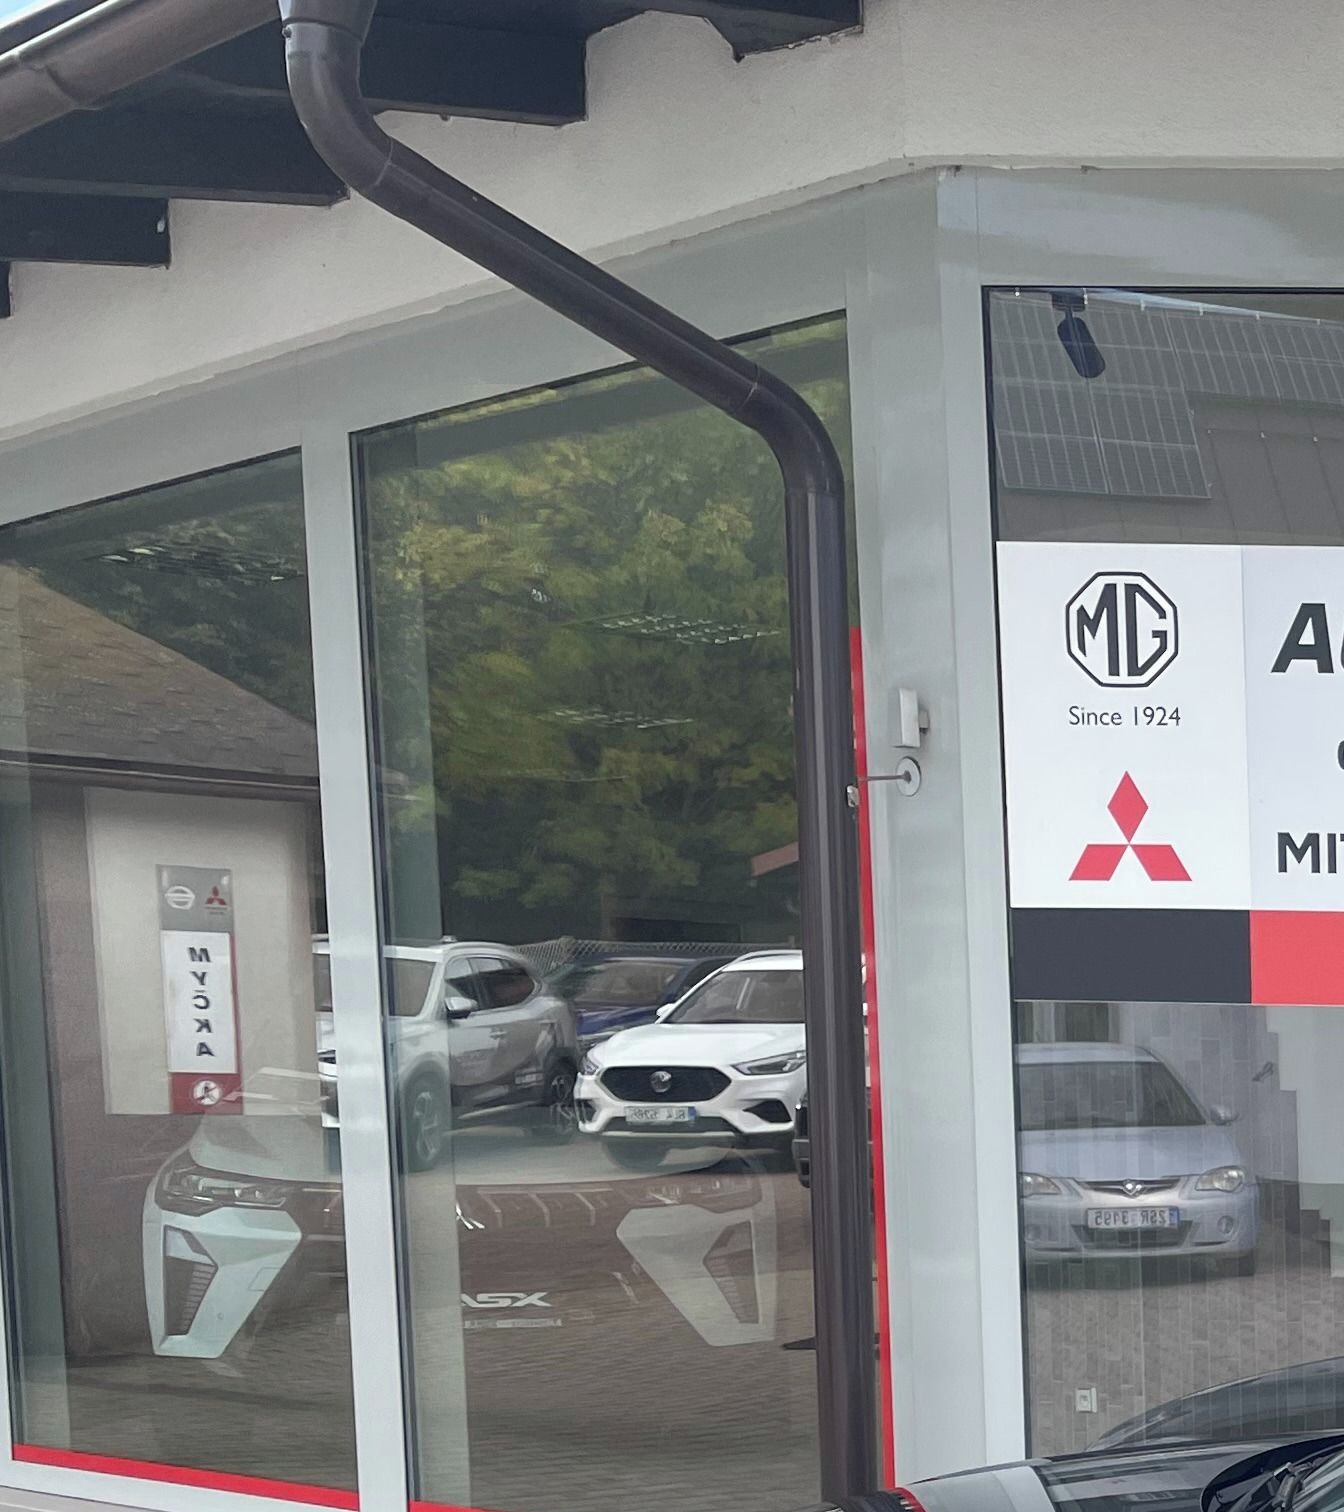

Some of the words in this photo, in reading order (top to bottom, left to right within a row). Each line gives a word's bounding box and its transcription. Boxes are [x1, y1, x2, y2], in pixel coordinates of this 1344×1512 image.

[1075, 581, 1169, 678] MG
[1068, 705, 1123, 726] Since
[1133, 706, 1181, 727] 1924
